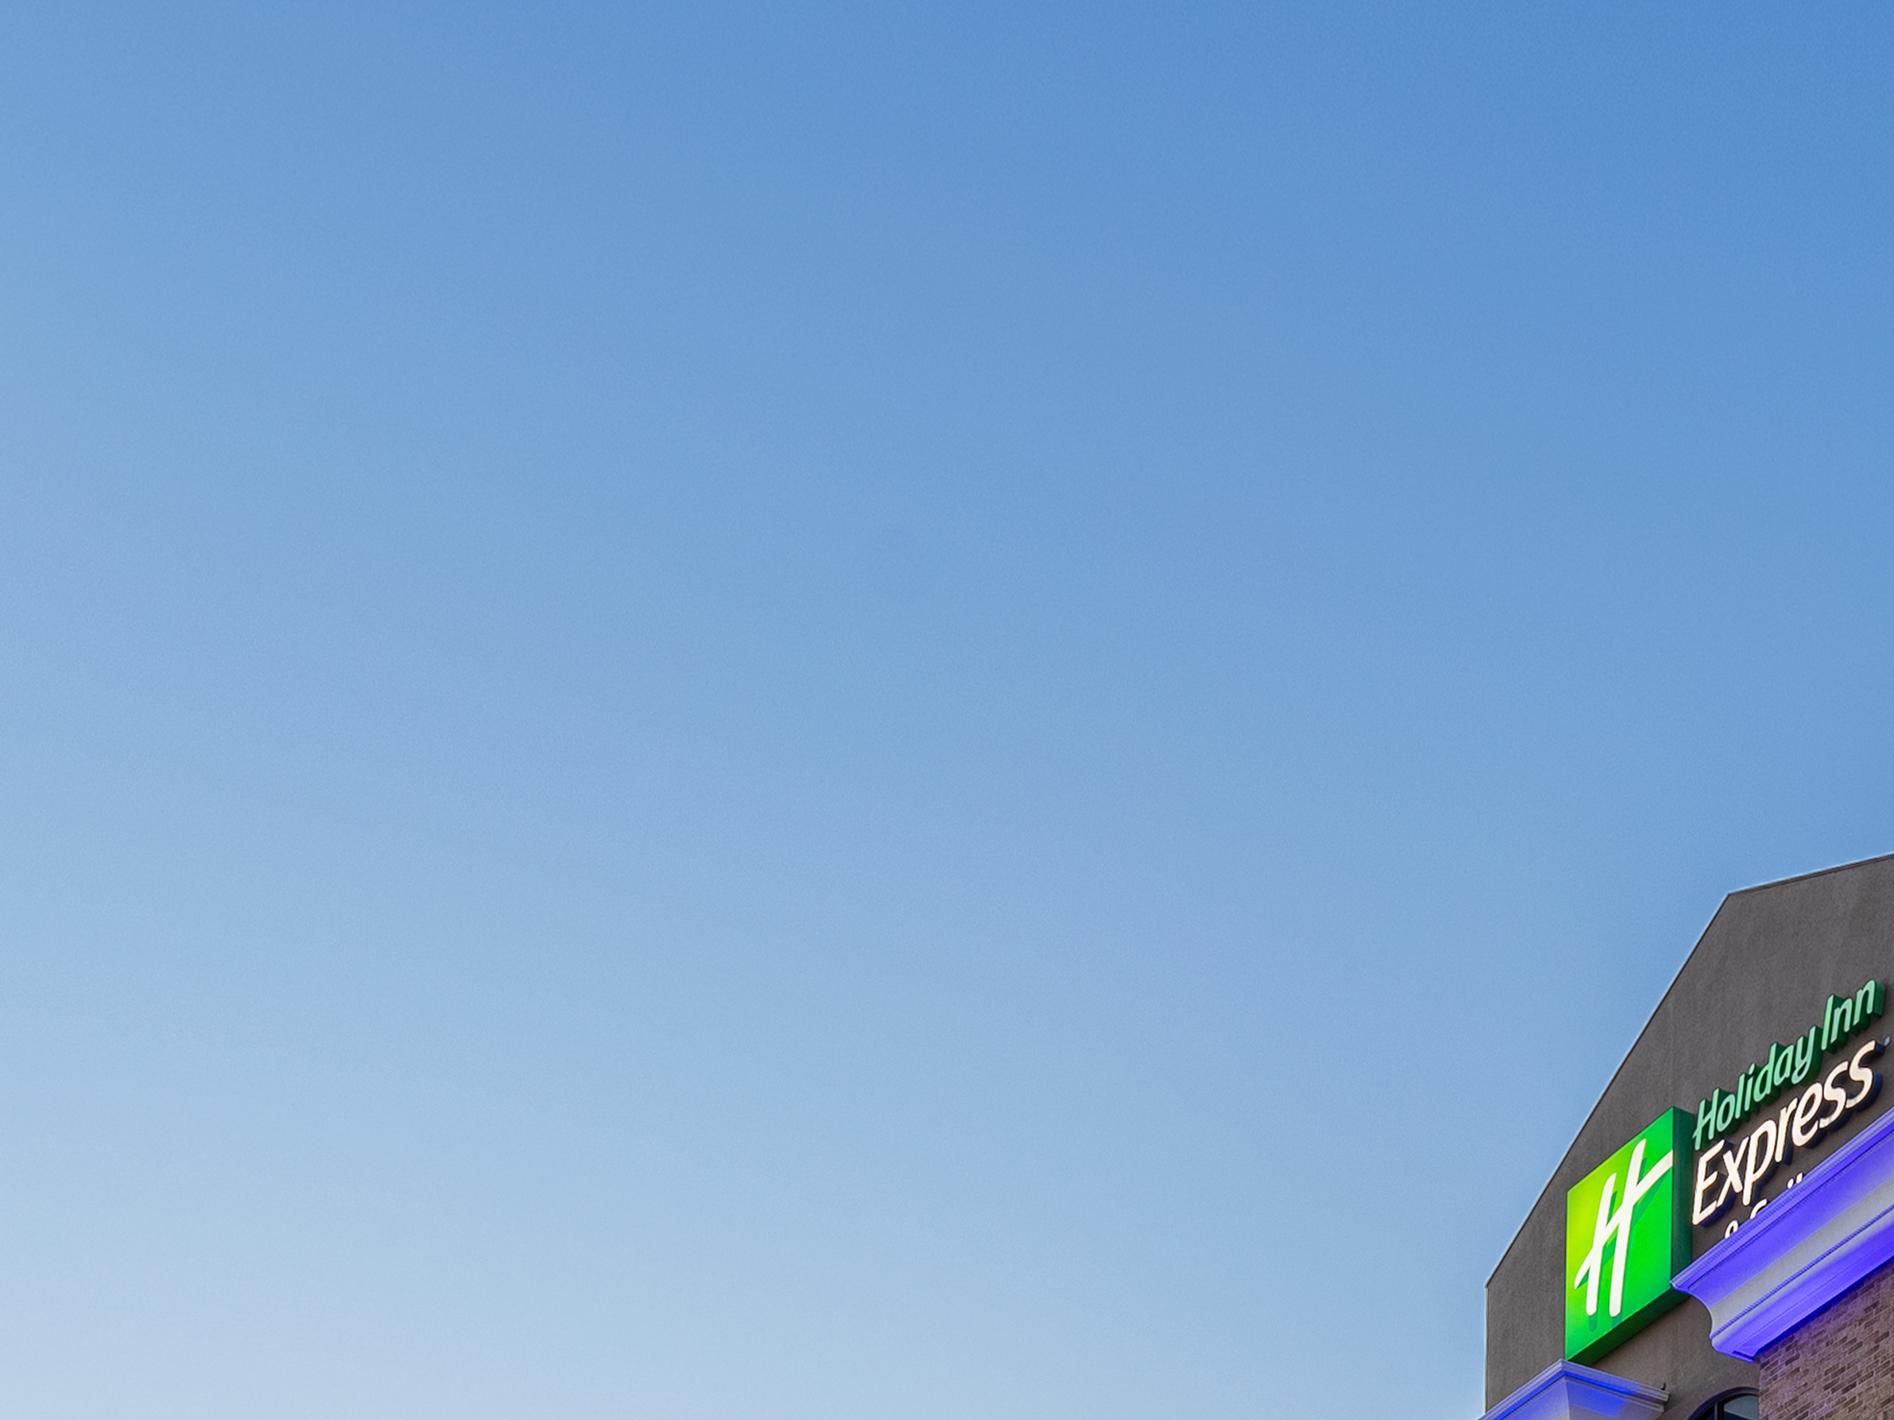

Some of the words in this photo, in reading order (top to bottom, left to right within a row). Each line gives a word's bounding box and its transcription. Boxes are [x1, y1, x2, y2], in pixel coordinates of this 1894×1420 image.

[1692, 1025, 1817, 1151] Holiday
[1821, 979, 1879, 1051] Inn
[1692, 1039, 1878, 1226] Express
[1573, 1138, 1673, 1317] H
